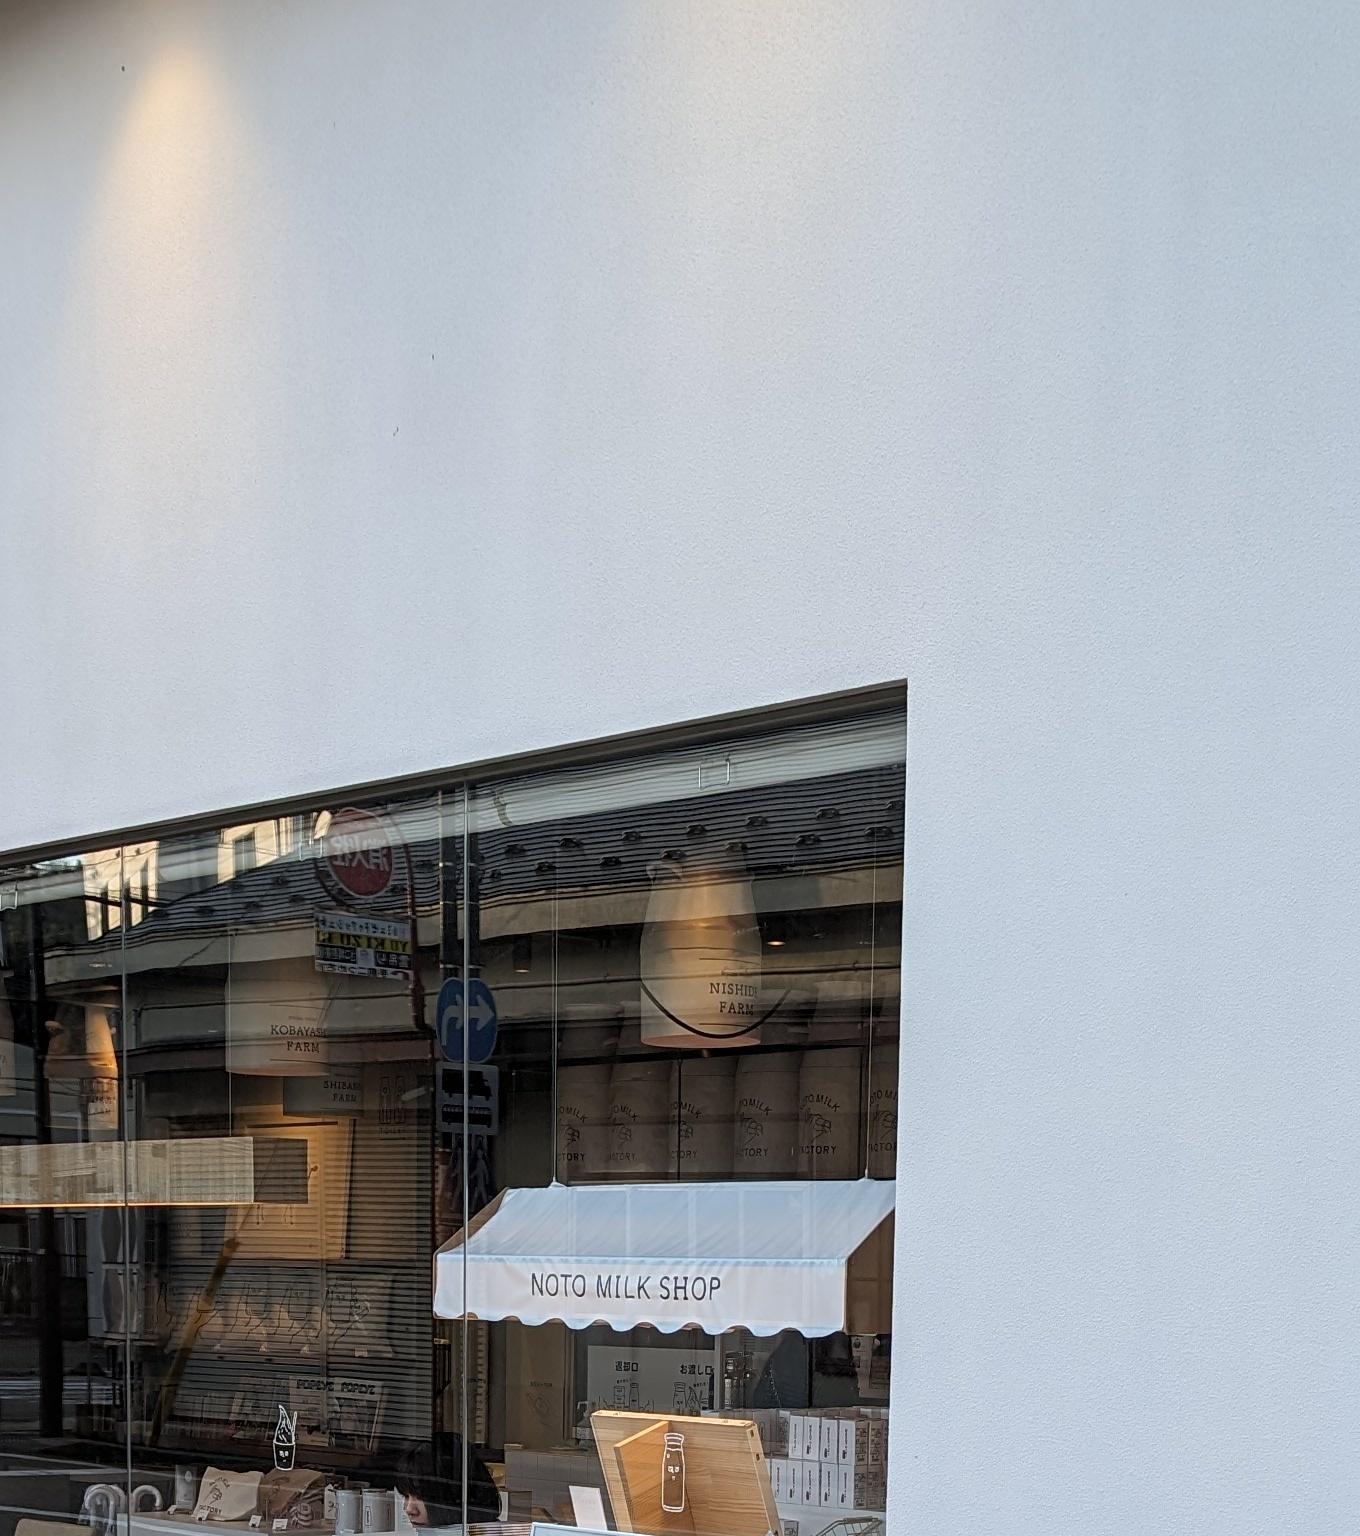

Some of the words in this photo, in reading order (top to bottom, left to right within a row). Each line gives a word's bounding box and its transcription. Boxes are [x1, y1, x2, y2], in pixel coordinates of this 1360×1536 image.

[719, 1001, 754, 1016] FARM
[270, 1024, 328, 1038] KOBAYASH
[287, 1041, 320, 1054] FARM
[531, 1272, 587, 1298] NOTO
[596, 1274, 652, 1300] MILK
[659, 1275, 721, 1301] SHOP
